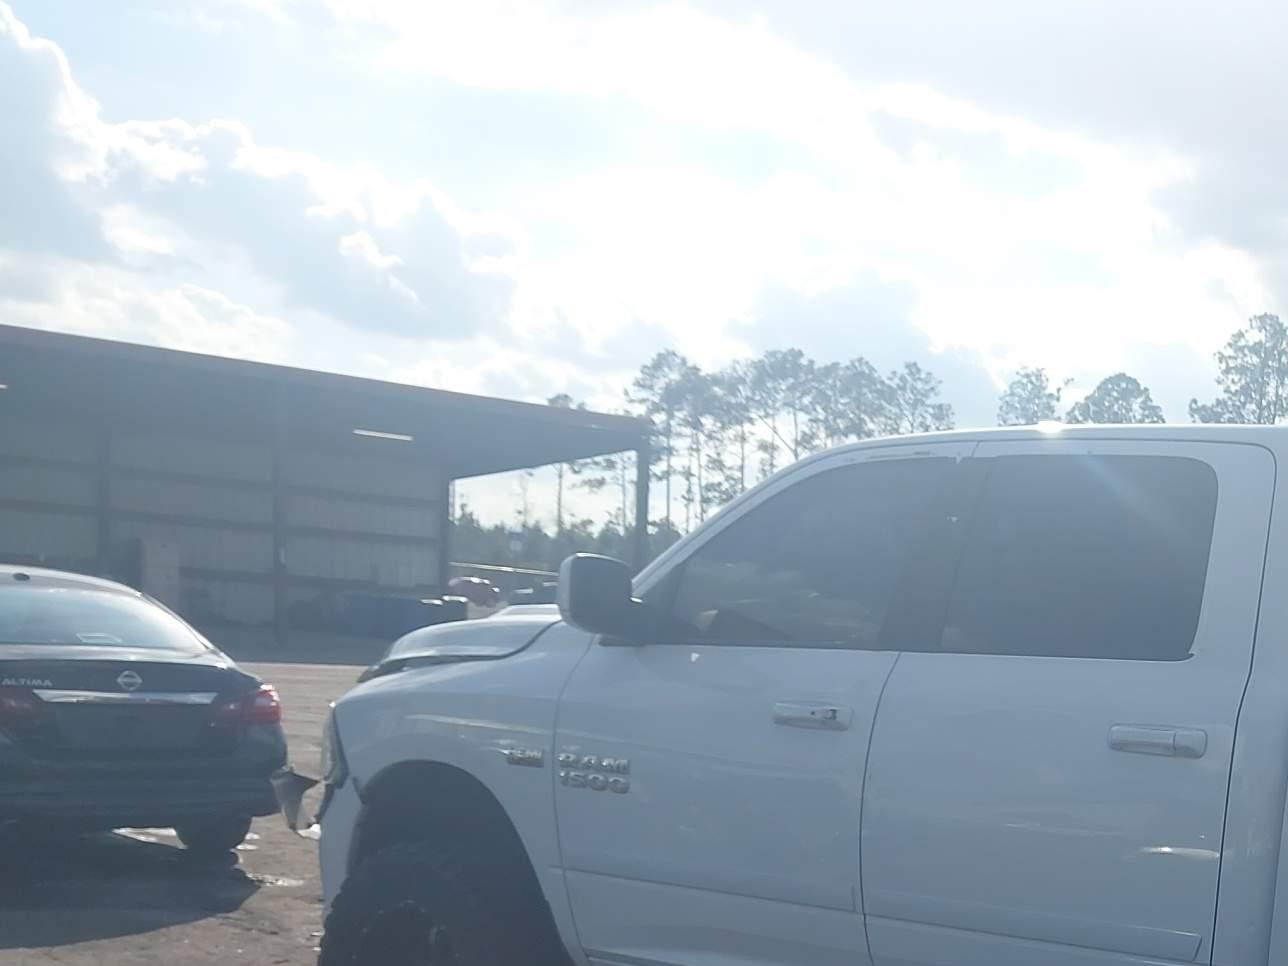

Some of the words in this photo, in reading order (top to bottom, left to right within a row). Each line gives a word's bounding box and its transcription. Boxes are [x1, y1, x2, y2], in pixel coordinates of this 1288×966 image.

[1, 677, 53, 687] ALTIMA
[558, 752, 630, 774] RAM
[559, 770, 631, 795] 1500
